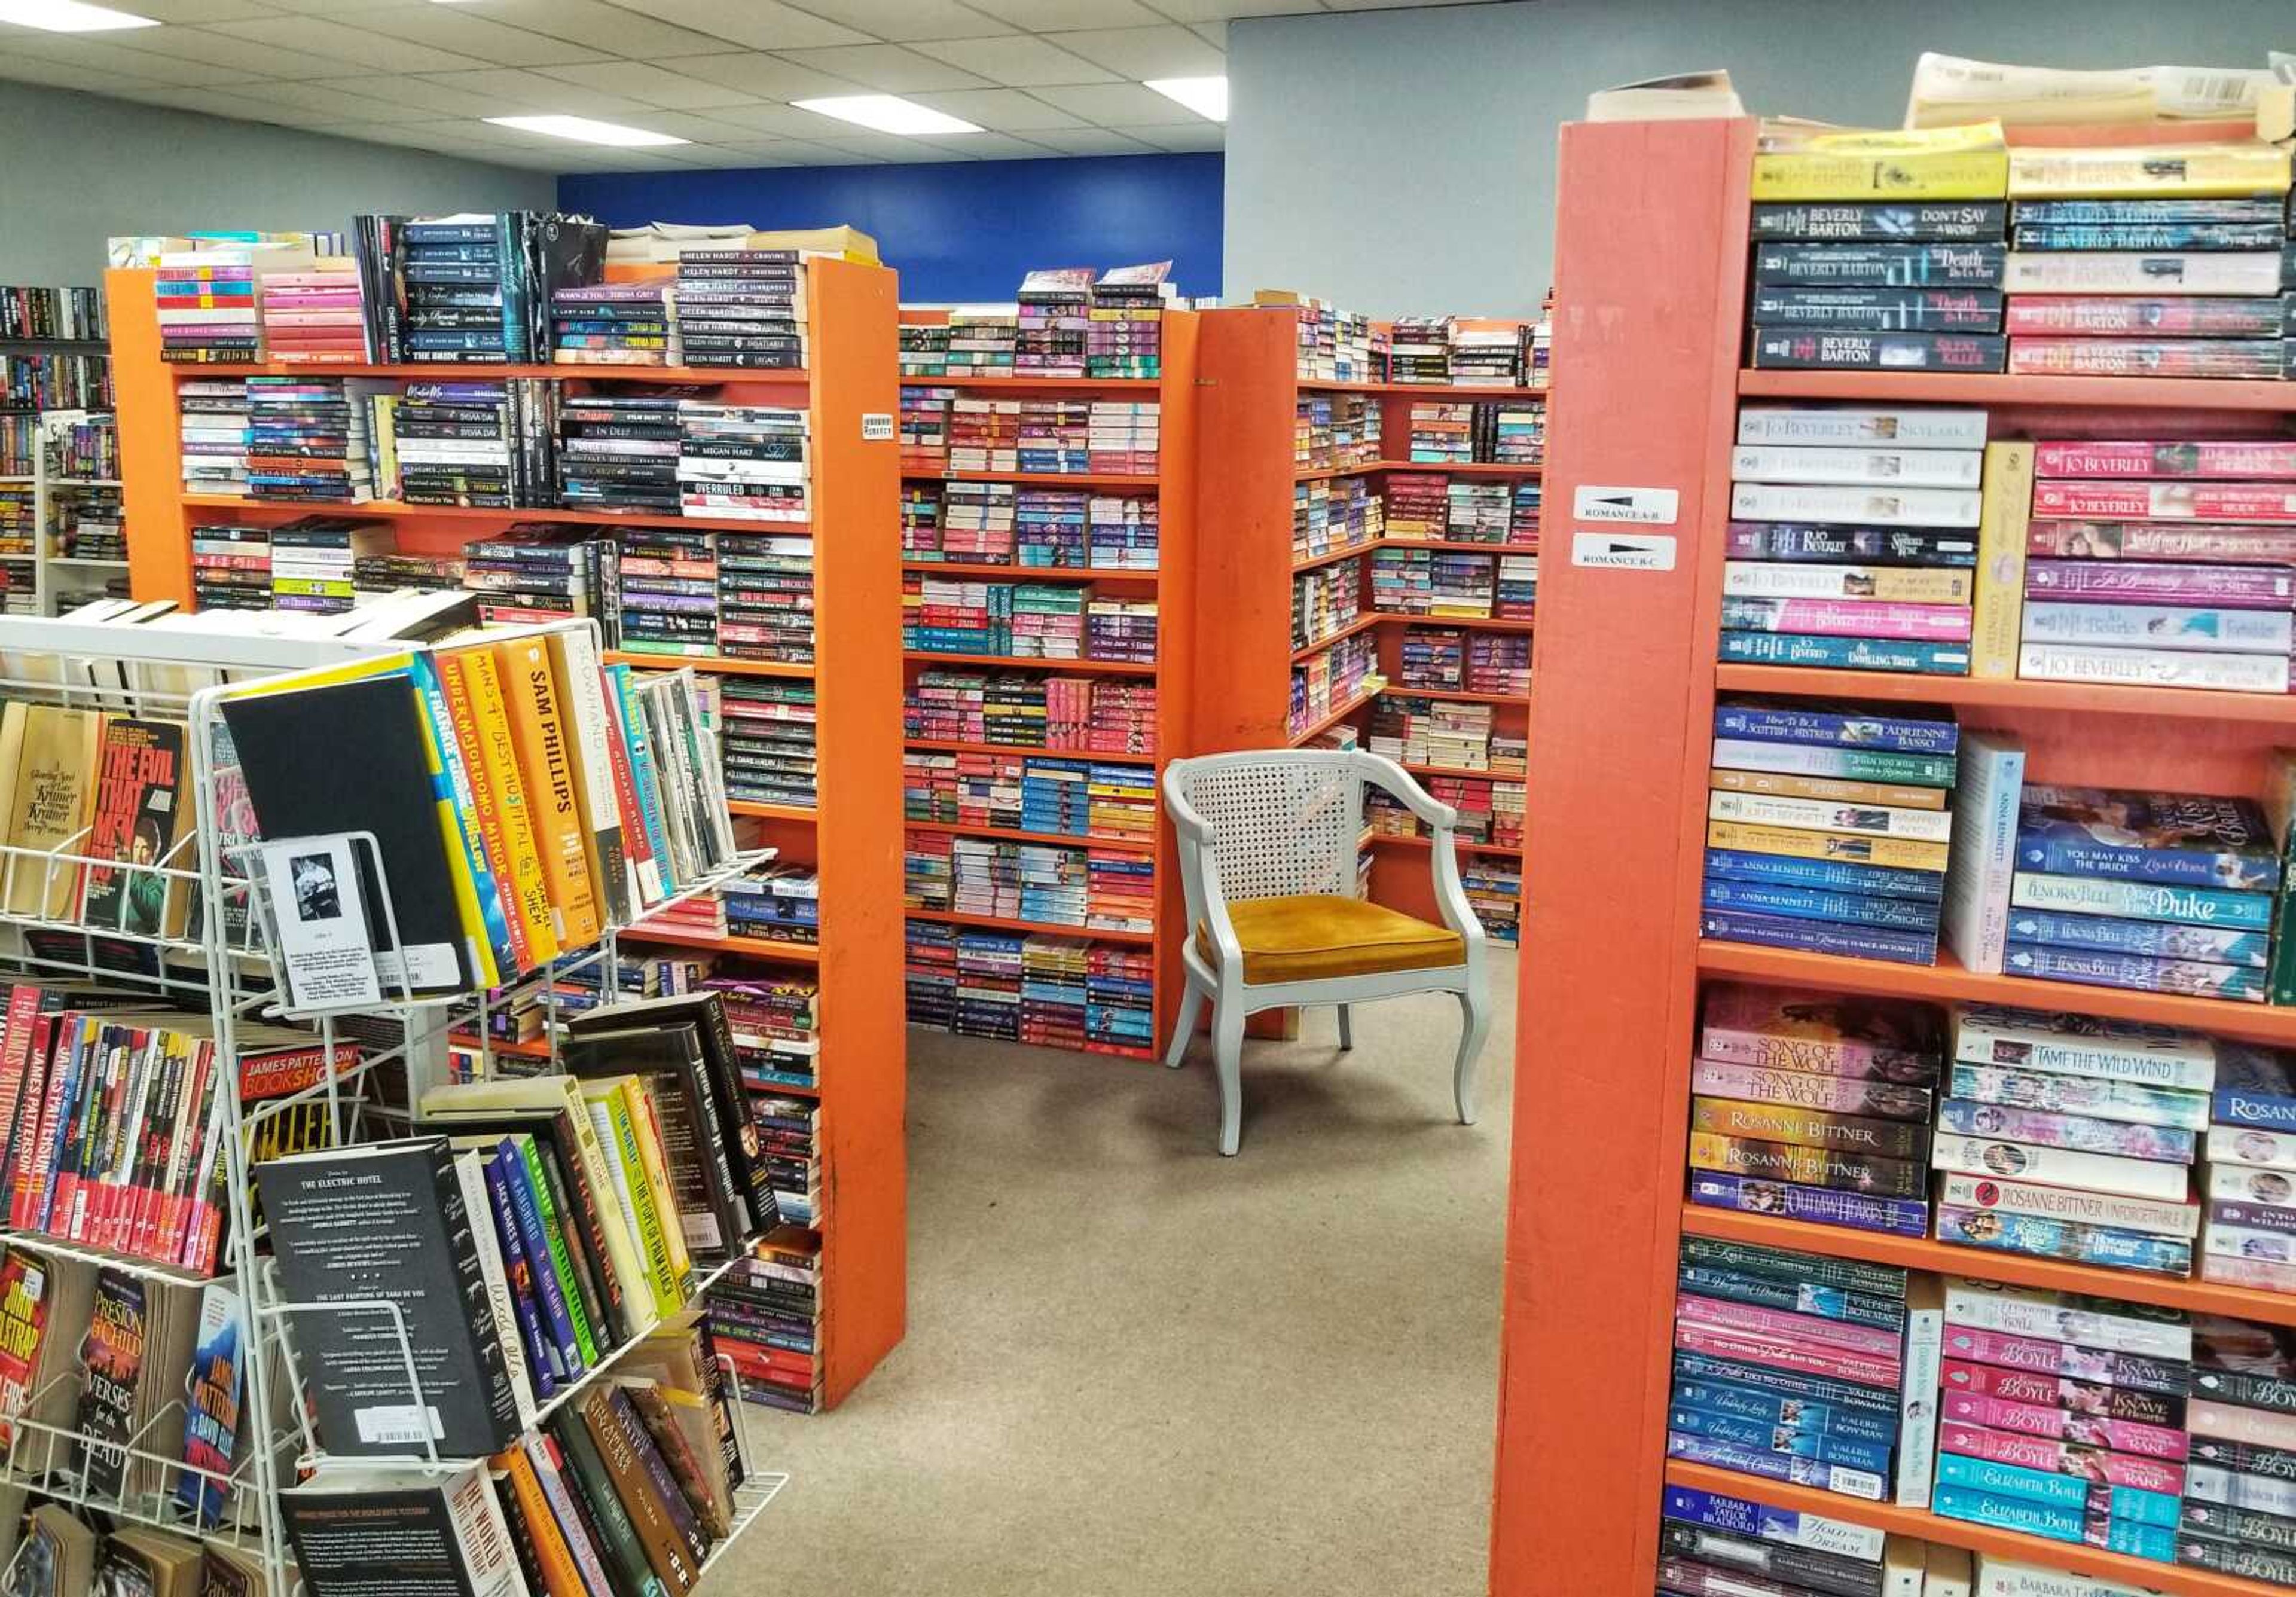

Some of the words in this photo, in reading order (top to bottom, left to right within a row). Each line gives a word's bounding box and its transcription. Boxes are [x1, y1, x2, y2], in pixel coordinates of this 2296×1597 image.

[1810, 208, 1862, 222] BEVERLY
[1961, 207, 1987, 222] SAY
[1809, 222, 1861, 236] BARTON
[716, 252, 740, 260] HARDT
[1940, 250, 1983, 268] Death
[684, 268, 710, 276] HELEN
[712, 268, 738, 276] HARDT
[1789, 261, 1840, 276] BEVERLY
[1843, 261, 1886, 276] BARTON
[680, 307, 706, 315] HELEN
[1785, 305, 1835, 320] BEVERLY
[1837, 305, 1882, 319] BARTON
[2075, 314, 2127, 328] BARTON
[683, 323, 710, 331] HELEN
[685, 338, 706, 347] HELEN
[1822, 337, 1872, 350] BEVERLY
[435, 352, 459, 361] BRIDE
[685, 355, 708, 364] HELEN
[710, 355, 733, 364] HARDT
[1821, 350, 1870, 362] BARTON
[2074, 356, 2127, 369] BARTON
[703, 447, 729, 456] MEGAN
[2084, 458, 2149, 472] BEVERLEY
[695, 484, 744, 496] OVERRULED
[1585, 509, 1636, 518] ROMANCE
[2086, 500, 2145, 514] BEVERLEY
[1584, 556, 1635, 564] ROMANCE
[2048, 658, 2069, 671] JO
[2073, 656, 2142, 676] BEVERLEY
[429, 690, 457, 759] FRANKIE
[1885, 725, 1948, 739] ADRIENNE
[530, 670, 552, 716] SAM
[541, 721, 572, 813] PHILLIPS
[1898, 736, 1935, 748] BASSO
[103, 746, 141, 781] THE
[141, 747, 176, 787] EVIL
[444, 663, 493, 816] UNDERMAJORDOMO
[484, 822, 507, 879] MINOR
[36, 786, 78, 804] Kramer
[100, 778, 146, 814] THAT
[492, 731, 512, 771] BEST
[505, 774, 530, 845] HOSPITAL
[27, 805, 71, 820] Kramer
[93, 811, 138, 852] MEN
[2067, 850, 2089, 860] YOU
[2092, 851, 2115, 862] MAY
[2118, 853, 2140, 865] KISS
[2075, 860, 2095, 869] THE
[2098, 860, 2129, 872] BRIDE
[1742, 861, 1769, 872] ANNA
[1770, 865, 1815, 876] BENNETT
[524, 890, 542, 926] SHEM
[535, 879, 552, 932] SAMUEL
[1739, 893, 1767, 905] ANNA
[1768, 895, 1814, 908] BENNETT
[2150, 886, 2216, 919] Duke
[1757, 1038, 1810, 1056] SONG
[1813, 1045, 1836, 1059] OF
[53, 1046, 72, 1096] JAMES
[248, 1061, 286, 1076] JAMES
[1754, 1051, 1787, 1067] THE
[1793, 1055, 1839, 1073] WOLF
[2037, 1046, 2070, 1064] TAME
[2072, 1050, 2094, 1069] THE
[2096, 1052, 2131, 1073] WILD
[2133, 1057, 2172, 1078] WIND
[28, 1048, 45, 1098] JAMES
[692, 1056, 713, 1099] Never
[1752, 1070, 1805, 1091] SONG
[1808, 1077, 1829, 1091] OF
[1748, 1082, 1781, 1098] THE
[1786, 1088, 1836, 1105] WOLF
[20, 1100, 40, 1173] PATTERSON
[36, 1092, 62, 1173] PATTERSON
[1732, 1112, 1803, 1133] ROSANNE
[1808, 1122, 1881, 1147] BITTNER
[1729, 1148, 1800, 1168] ROSANNE
[1805, 1159, 1871, 1179] BITTNER
[319, 1177, 355, 1188] ELECTRIC
[357, 1175, 382, 1184] HOTEL
[635, 1182, 647, 1203] THE
[2002, 1189, 2056, 1212] ROSANNE
[2057, 1197, 2102, 1217] BITTNER
[496, 1181, 509, 1207] JACK
[503, 1210, 517, 1242] WAKES
[511, 1242, 521, 1256] UP
[514, 1175, 541, 1241] RANCHERO
[640, 1202, 655, 1227] POPE
[652, 1239, 666, 1269] PALM
[658, 1269, 674, 1297] BEACH
[5, 1279, 34, 1322] JOHN
[93, 1288, 144, 1333] PRESTON
[102, 1319, 142, 1357] CHILD
[1999, 1343, 2059, 1368] BOYLE
[2117, 1358, 2171, 1382] KNAVE
[86, 1371, 133, 1413] VERSES
[1996, 1375, 2057, 1402] BOYLE
[2114, 1393, 2169, 1416] KNAVE
[95, 1405, 108, 1421] for
[106, 1410, 117, 1429] the
[2002, 1407, 2060, 1435] BOYLE
[197, 1412, 219, 1447] DAVID
[1836, 1421, 1884, 1439] BOWMAN
[78, 1423, 130, 1471] DEAD
[1832, 1442, 1873, 1456] VALERIE
[1997, 1440, 2057, 1468] BOYLE
[1827, 1450, 1874, 1468] BOWMAN
[1983, 1468, 2044, 1494] ELIZABETH
[2125, 1470, 2165, 1489] RAKE
[1709, 1494, 1752, 1514] BARBARA
[1713, 1506, 1746, 1521] TAYLOR
[1979, 1498, 2041, 1524] ELIZABETH
[462, 1477, 482, 1511] THE
[475, 1514, 503, 1571] WORLD
[1703, 1512, 1755, 1533] BRADFORD
[1809, 1516, 1850, 1535] HOLD
[451, 1493, 469, 1523] UNTIL
[462, 1523, 490, 1578] YESTERDAY
[1808, 1533, 1861, 1553] DREAM
